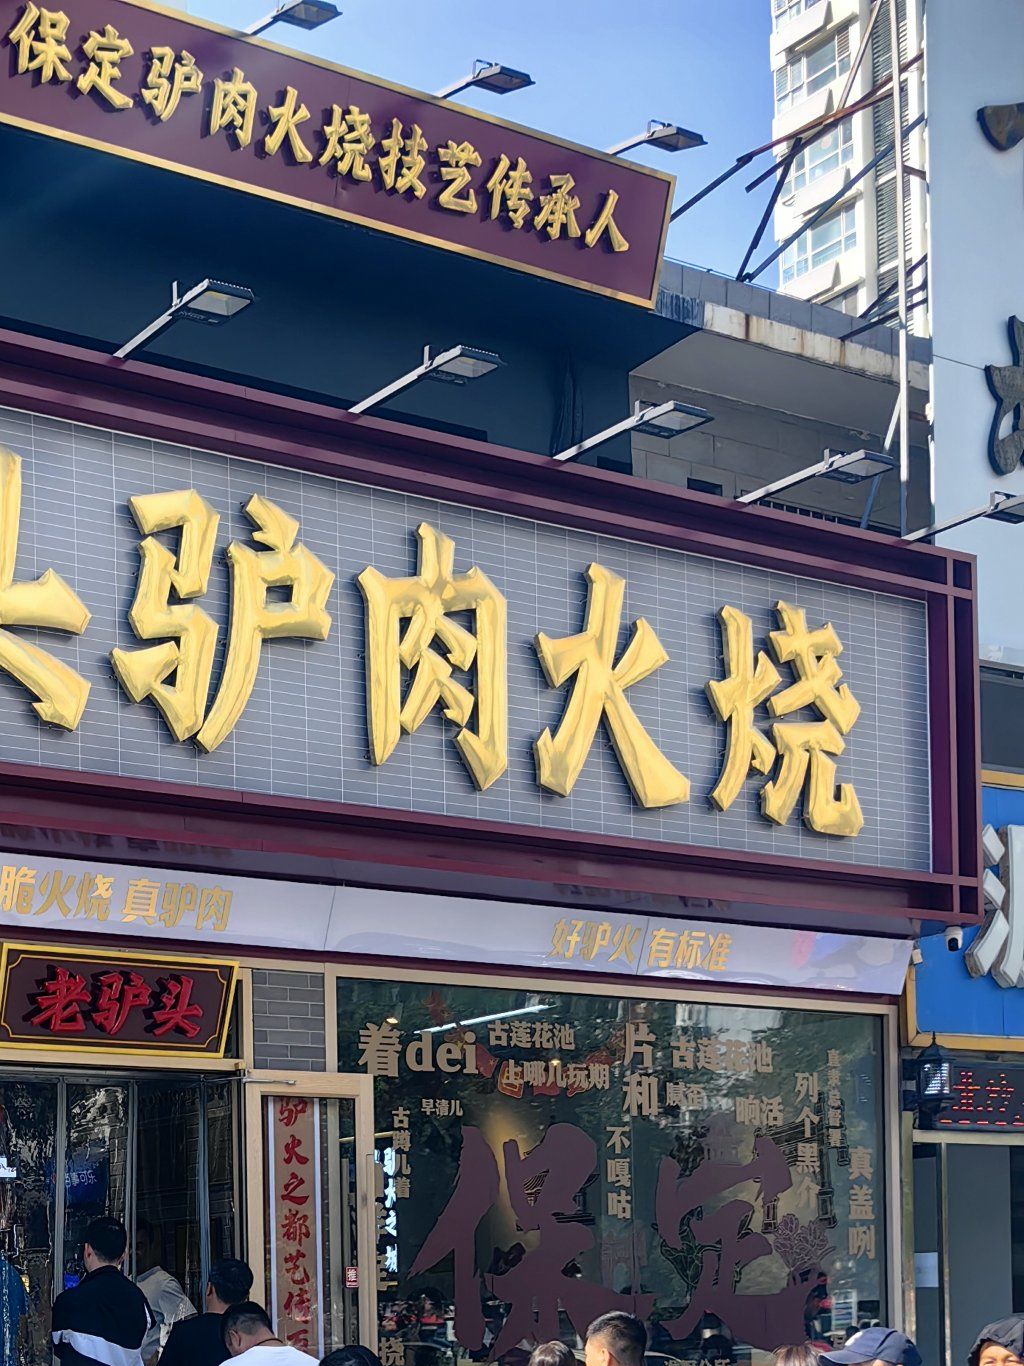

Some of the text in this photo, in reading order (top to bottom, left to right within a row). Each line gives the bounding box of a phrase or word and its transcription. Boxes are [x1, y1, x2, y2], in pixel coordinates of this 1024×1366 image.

[9, 1, 630, 254] 保定驴肉火烧技艺传承人
[121, 878, 234, 932] 真驴肉
[647, 928, 733, 973] 有标准
[30, 967, 203, 1038] 老驴头
[487, 1020, 575, 1050] 古莲花池
[421, 1099, 463, 1117] 早清儿
[849, 1146, 875, 1260] 真盖咧
